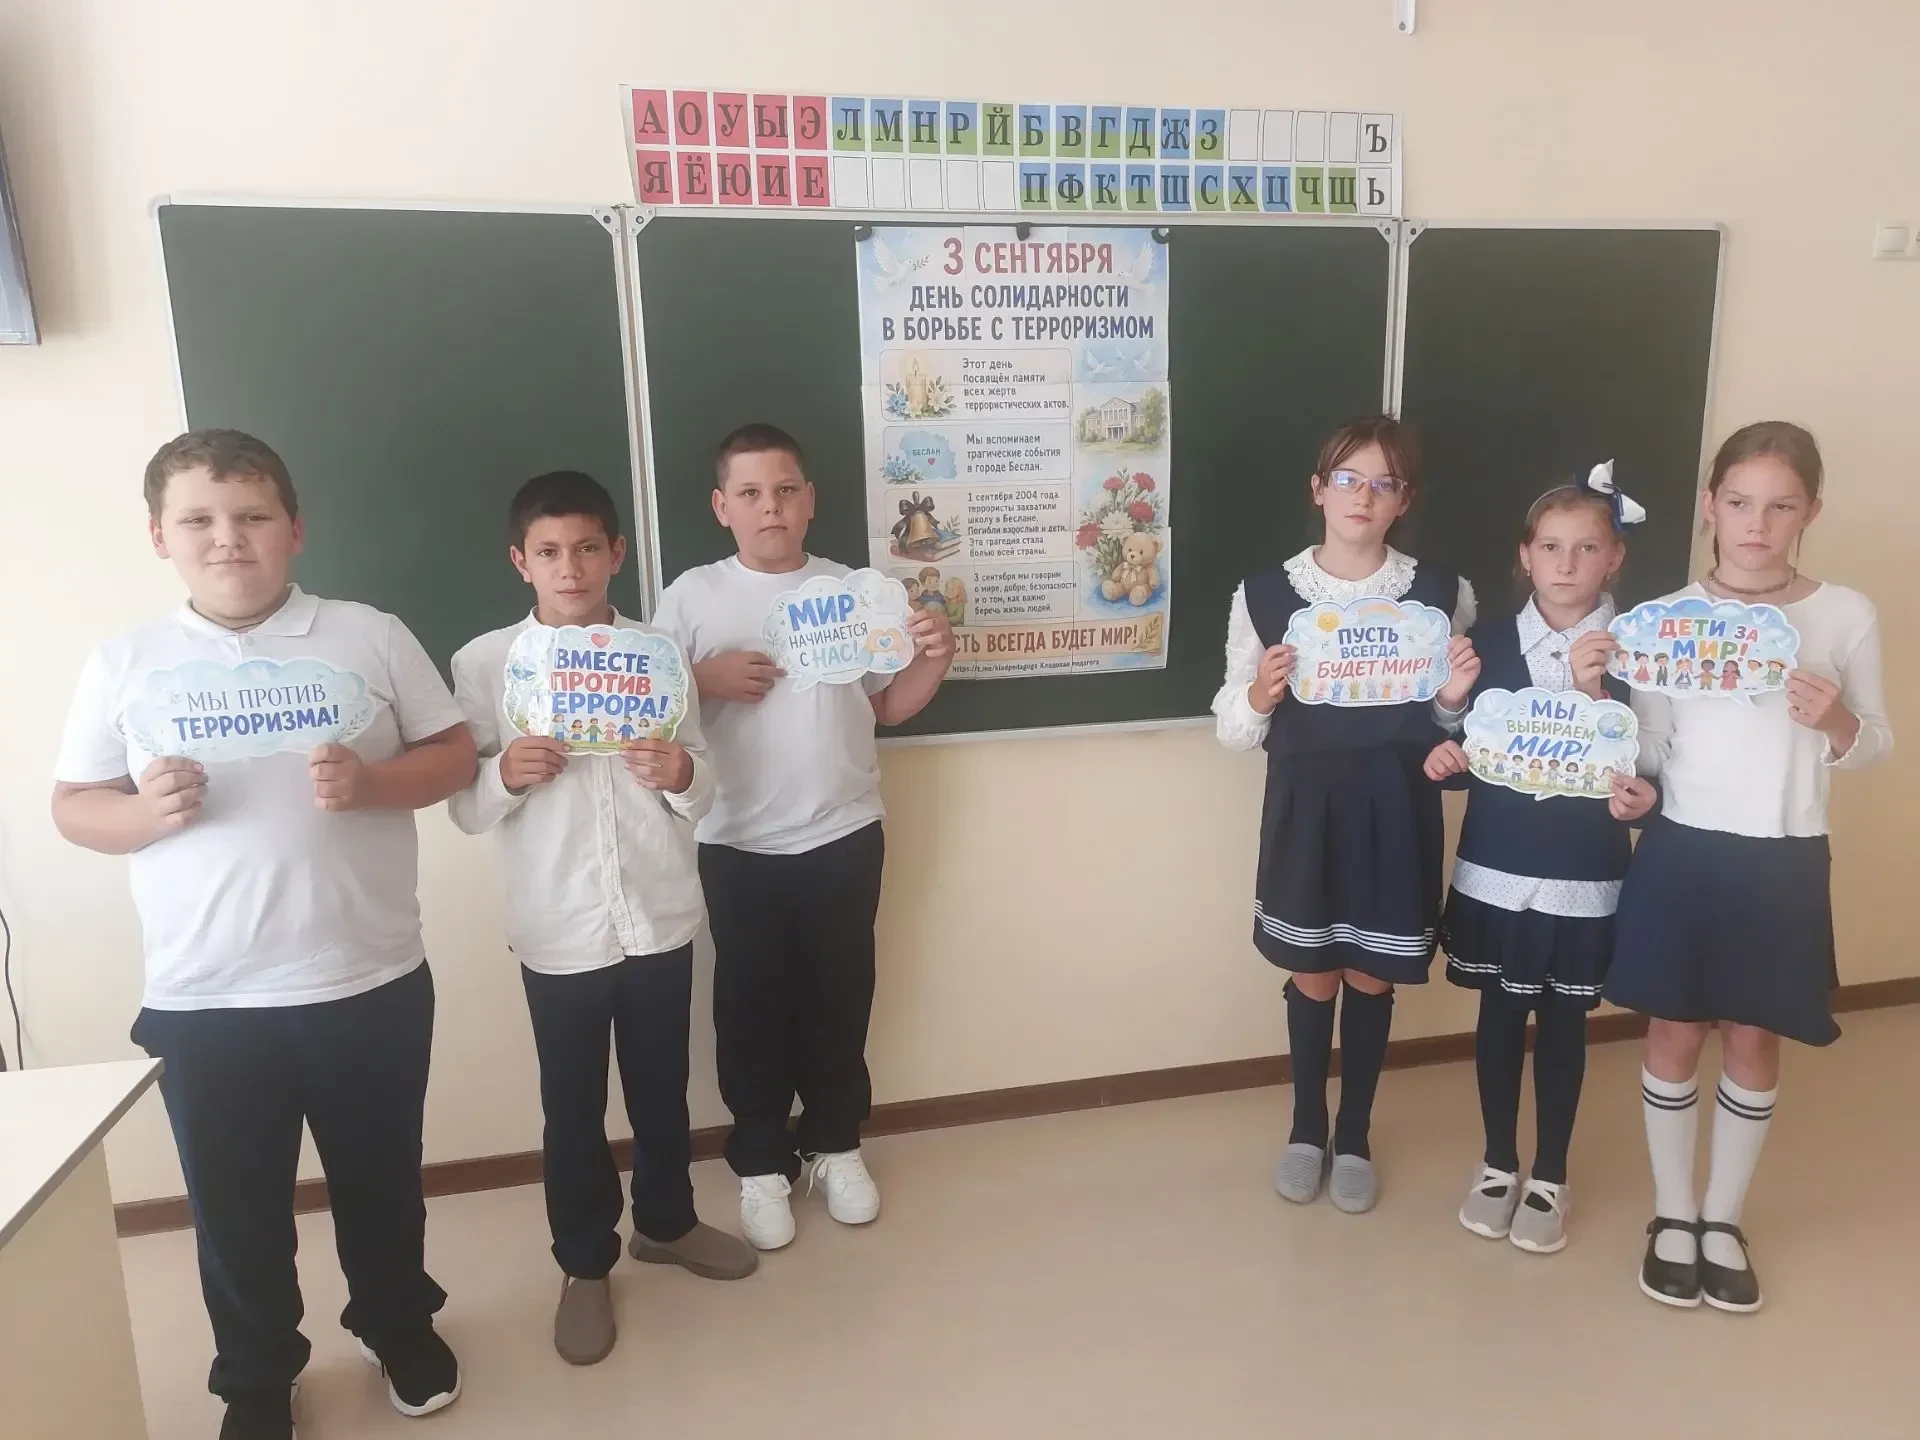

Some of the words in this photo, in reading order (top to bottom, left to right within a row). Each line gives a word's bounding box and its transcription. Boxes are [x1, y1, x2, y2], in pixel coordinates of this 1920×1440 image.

[638, 100, 666, 134] А
[678, 101, 703, 136] О
[718, 103, 743, 137] У
[753, 104, 788, 138] Ы
[801, 106, 821, 138] Э
[836, 108, 862, 141] Л
[874, 109, 903, 142] М
[912, 111, 937, 143] Н
[949, 112, 970, 144] Р
[987, 106, 1011, 146] Й
[1022, 115, 1044, 146] Б
[1061, 115, 1082, 148] В
[1097, 116, 1116, 148] Г
[1128, 118, 1151, 156] Д
[1160, 118, 1190, 150] Ж
[1200, 119, 1218, 151] З
[1365, 124, 1387, 153] Ъ
[643, 161, 669, 195] Я
[684, 155, 707, 195] Ё
[718, 163, 752, 196] Ю
[762, 165, 788, 197] И
[802, 167, 825, 199] Е
[1022, 173, 1048, 203] П
[1057, 174, 1084, 204] Ф
[1095, 174, 1118, 204] К
[1130, 175, 1151, 204] Т
[1161, 175, 1190, 204] Ш
[1200, 175, 1219, 205] С
[1231, 176, 1256, 205] Х
[1265, 176, 1290, 210] Ц
[1299, 176, 1321, 205] Ч
[1328, 176, 1357, 213] Щ
[1366, 178, 1385, 206] Ь
[943, 237, 964, 276] 3
[974, 242, 1113, 274] СЕНТЯБРЯ
[909, 285, 963, 312] ДЕНЬ
[970, 284, 1129, 312] СОЛИДАРНОСТИ
[882, 317, 895, 341] В
[903, 316, 982, 341] БОРЬБЕ
[991, 316, 1003, 340] С
[1011, 315, 1154, 340] ТЕРРОРИЗМОМ
[962, 357, 986, 369] Этот
[989, 360, 1013, 370] день
[1012, 374, 1045, 383] памяти
[964, 387, 985, 396] всех
[988, 387, 1016, 398] жертв
[964, 400, 1042, 412] террористических
[1043, 400, 1070, 409] актов.
[966, 433, 983, 445] Мы
[986, 434, 1041, 446] вспоминаем
[912, 447, 941, 456] БЕСЛАН
[967, 449, 1022, 461] трагические
[1024, 446, 1061, 457] события
[967, 465, 972, 473] в
[975, 463, 1006, 475] городе
[1008, 461, 1043, 472] Беслан.
[968, 492, 972, 501] 1
[975, 492, 1013, 503] сентября
[1015, 490, 1038, 500] 2004
[968, 505, 1014, 514] террористы
[1017, 503, 1057, 511] захватили
[968, 516, 992, 525] школу
[1003, 514, 1038, 523] Беслане.
[968, 526, 1000, 535] Погибли
[1003, 526, 1039, 535] взрослые
[969, 538, 983, 546] Эта
[986, 538, 1020, 547] трагедия
[1022, 537, 1044, 545] стала
[969, 549, 995, 557] болью
[997, 547, 1015, 556] всей
[1017, 548, 1047, 556] страны.
[974, 573, 979, 582] 3
[982, 572, 1016, 581] сентября
[1031, 571, 1061, 580] говорим
[981, 586, 1002, 594] мире,
[1004, 583, 1028, 593] добре,
[1029, 582, 1077, 591] безопасности
[1022, 594, 1046, 602] важно
[787, 594, 855, 632] МИР
[974, 606, 1000, 616] беречь
[788, 622, 868, 650] НАЧИНАЕТСЯ
[954, 633, 980, 653] СТЬ
[987, 631, 1046, 654] ВСЕГДА
[1052, 628, 1096, 650] БУДЕТ
[1100, 624, 1137, 646] МИР!
[1337, 627, 1399, 645] ПУСТЬ
[1658, 618, 1726, 639] ДЕТИ
[1734, 625, 1759, 643] ЗА
[554, 648, 650, 674] ВМЕСТЕ
[800, 652, 809, 667] С
[812, 640, 859, 668] НАС!
[1341, 644, 1399, 659] ВСЕГДА
[1672, 640, 1749, 662] МИР!
[1317, 660, 1378, 679] БУДЕТ
[1382, 657, 1433, 676] МИР!
[550, 672, 652, 695] ПРОТИВ
[187, 691, 229, 713] МЫ
[238, 683, 326, 709] ПРОТИВ
[532, 690, 669, 719] ЕРРОРА!
[1530, 699, 1577, 722] МЫ
[171, 704, 340, 743] ТЕРРОРИЗМА!
[1506, 719, 1597, 742] ВЫБИРАЕМ
[1507, 735, 1592, 762] МИР!
